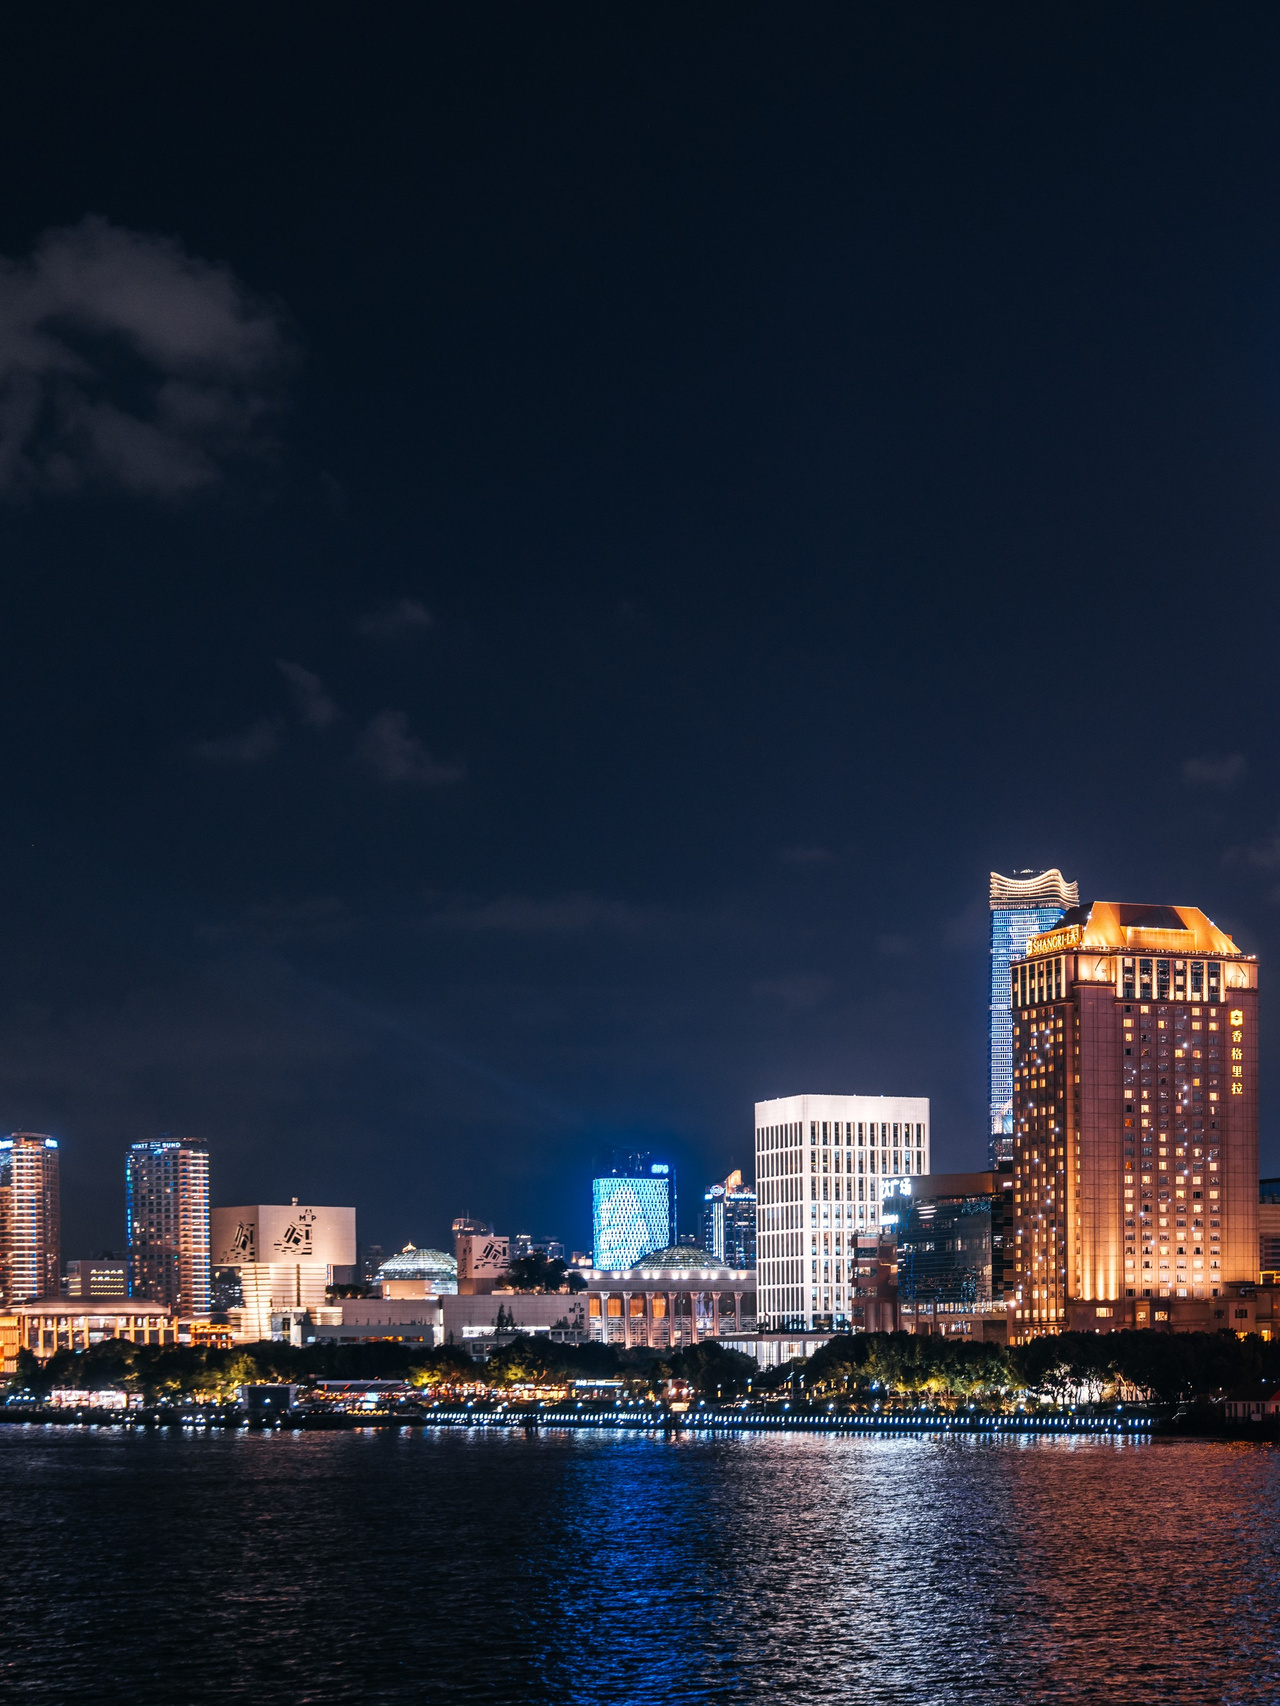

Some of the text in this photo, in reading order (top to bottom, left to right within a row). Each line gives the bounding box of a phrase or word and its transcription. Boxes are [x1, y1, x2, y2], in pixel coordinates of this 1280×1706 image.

[1033, 927, 1079, 953] SHANGRI-LA
[1231, 1030, 1243, 1095] 香格里拉
[651, 1164, 669, 1174] SIPG
